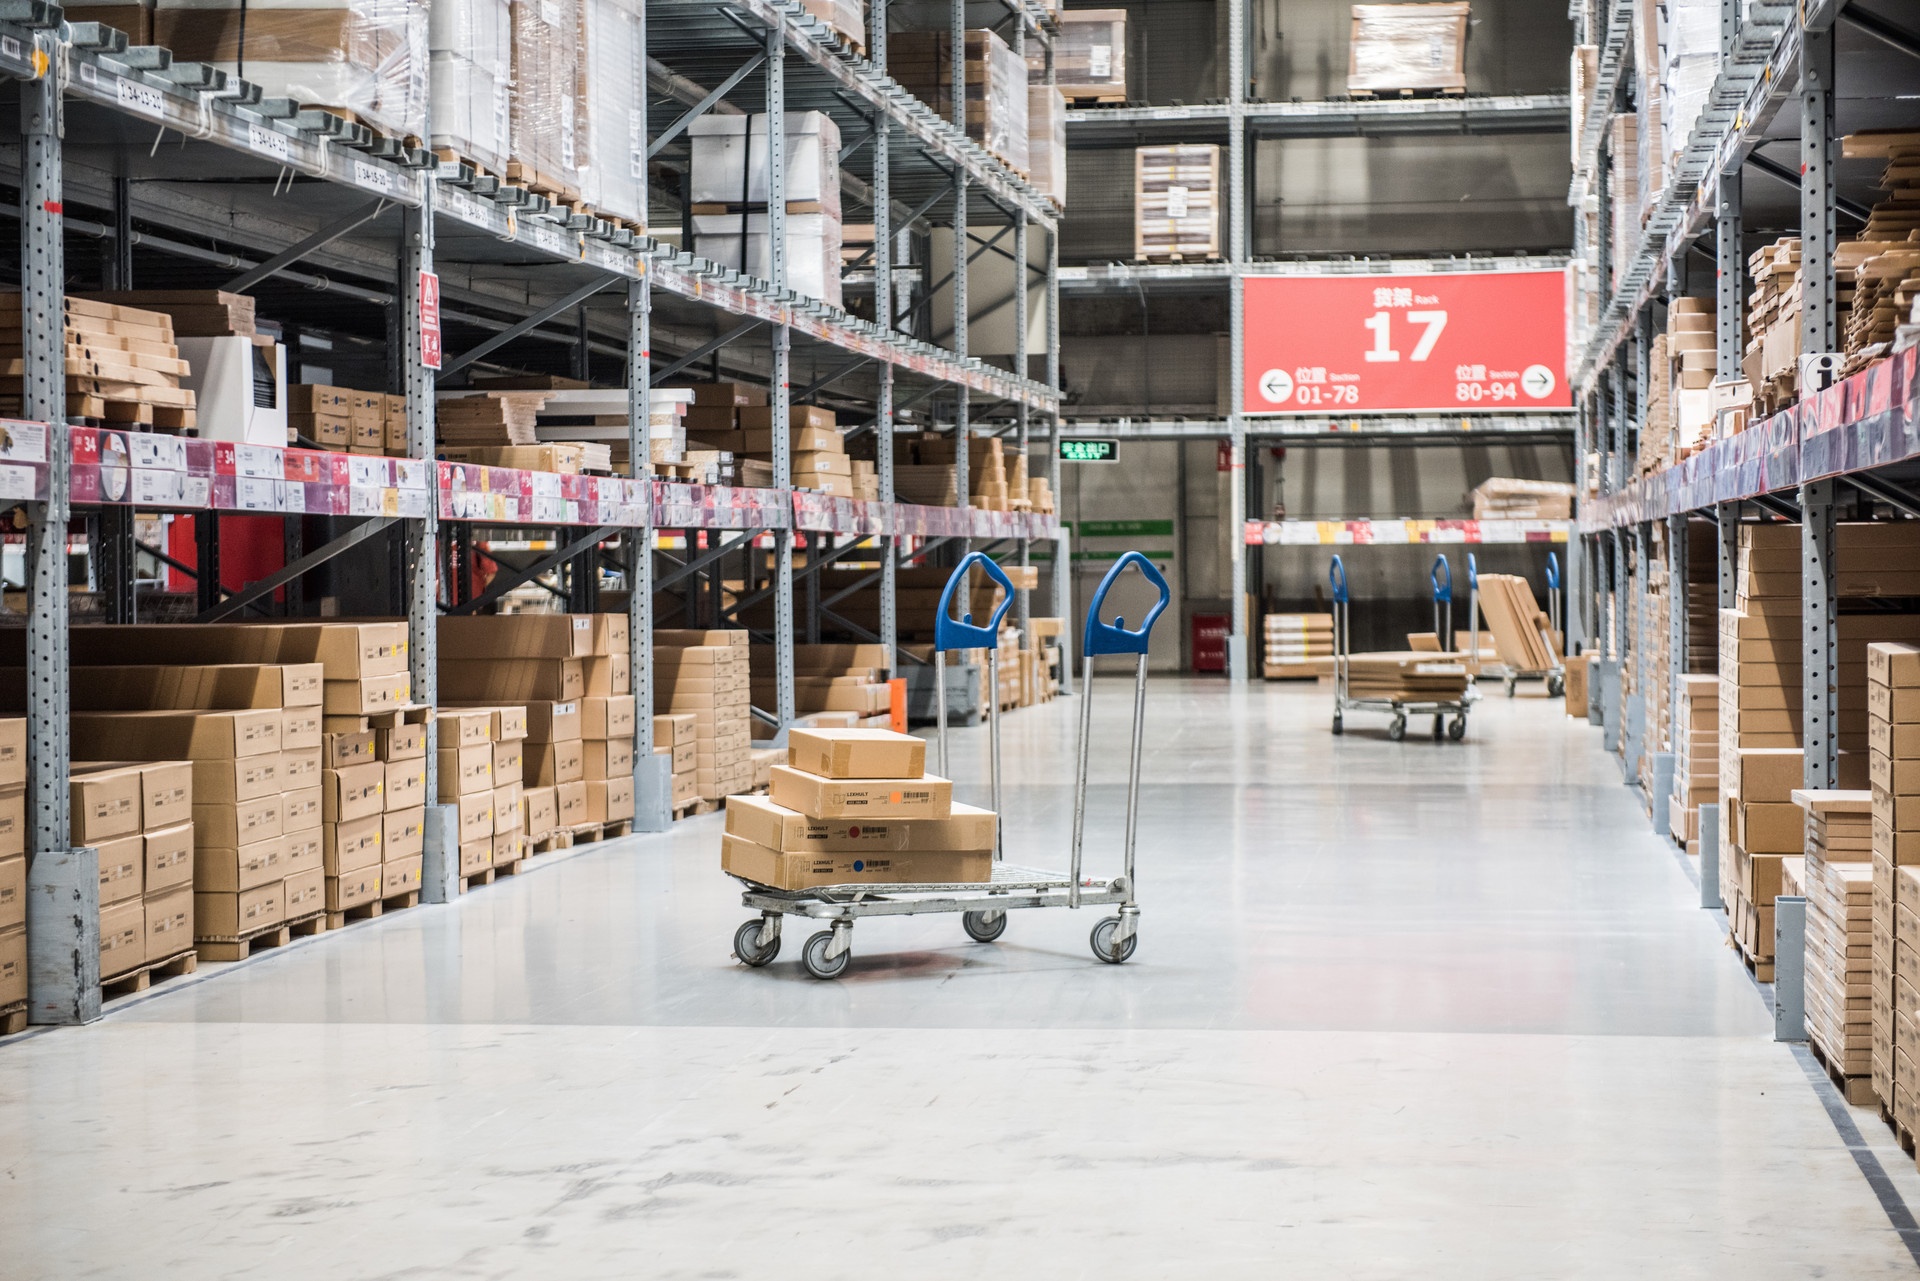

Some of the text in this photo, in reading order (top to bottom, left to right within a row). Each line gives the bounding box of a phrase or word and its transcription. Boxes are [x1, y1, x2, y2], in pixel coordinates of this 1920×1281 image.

[1414, 294, 1440, 305] Rack
[1364, 310, 1448, 362] 17
[1295, 367, 1361, 384] 位置 Section
[1455, 364, 1520, 381] 位置 Section
[1296, 385, 1359, 405] 01-78
[1455, 382, 1517, 402] 80-94
[84, 436, 97, 452] 34
[225, 450, 234, 464] 34
[340, 461, 348, 475] 34
